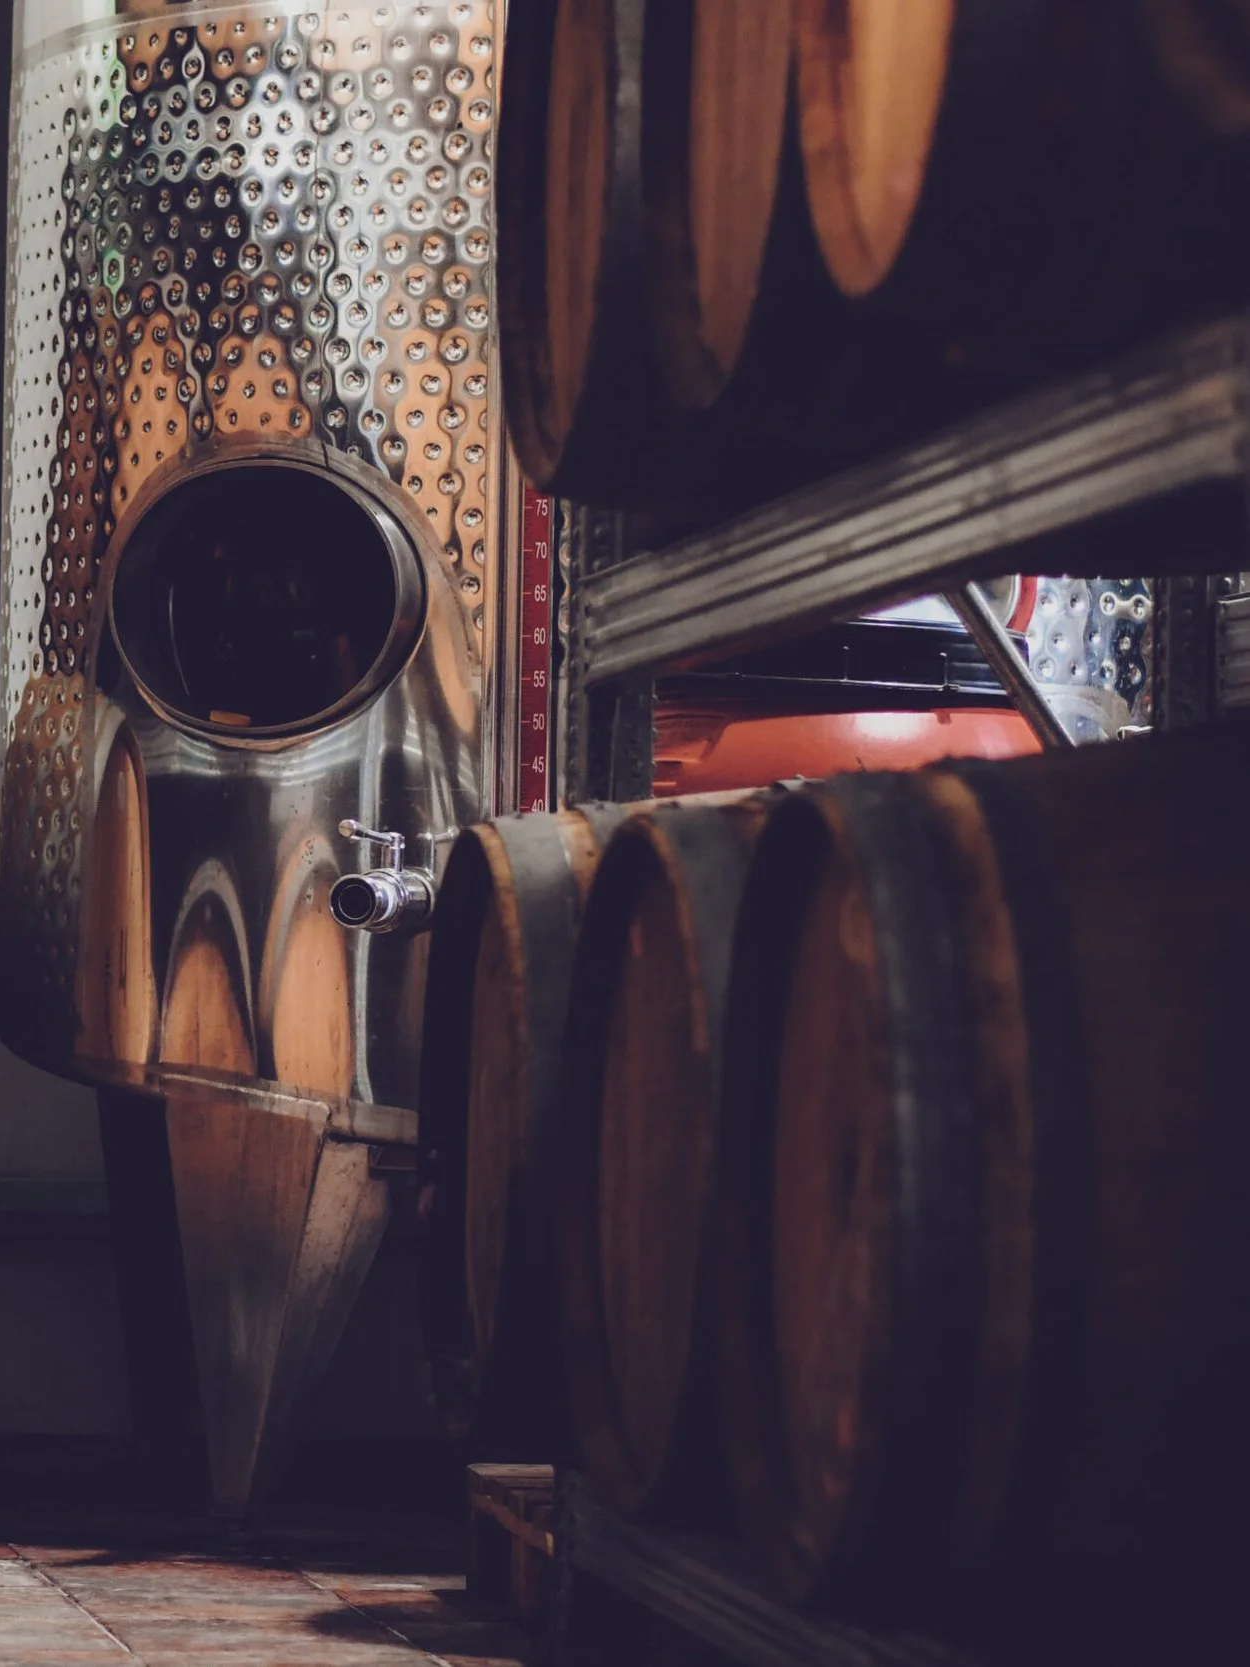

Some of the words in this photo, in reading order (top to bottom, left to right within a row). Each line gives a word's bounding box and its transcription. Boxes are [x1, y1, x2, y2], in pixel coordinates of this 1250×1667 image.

[536, 499, 548, 516] 75
[535, 542, 547, 559] 70
[534, 584, 547, 602] 65
[533, 627, 546, 645] 60
[533, 670, 545, 688] 55
[532, 713, 545, 730] 50
[532, 756, 544, 773] 45
[531, 799, 543, 812] 40
